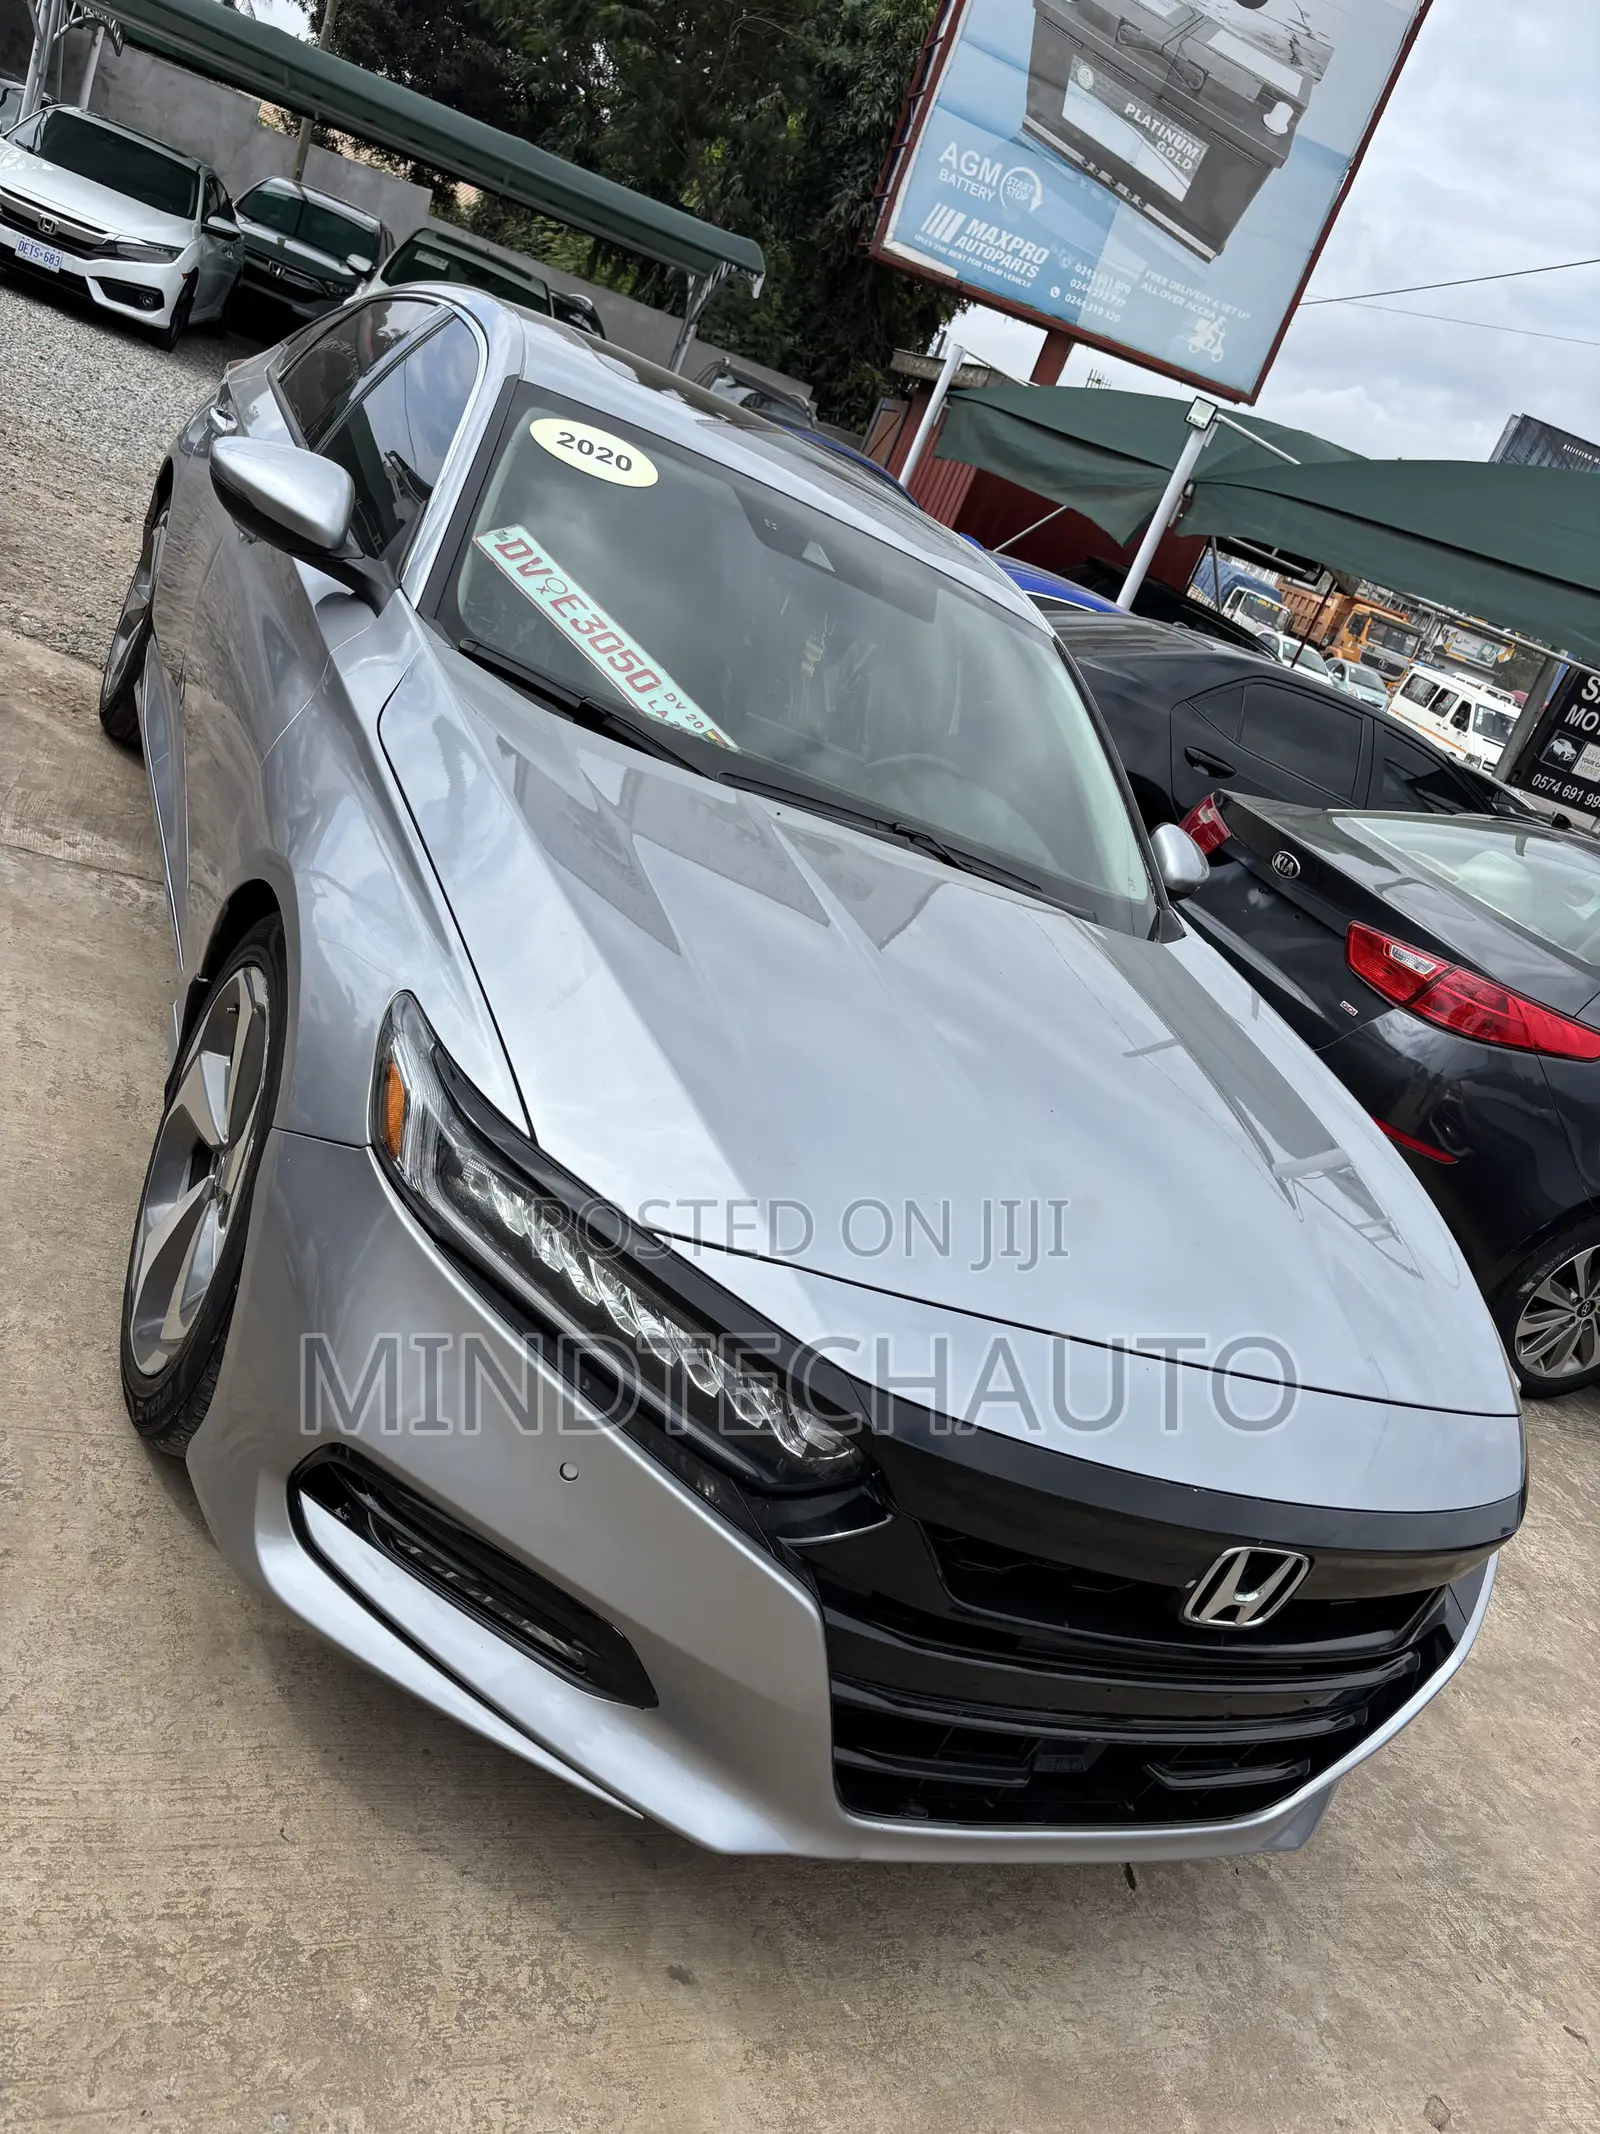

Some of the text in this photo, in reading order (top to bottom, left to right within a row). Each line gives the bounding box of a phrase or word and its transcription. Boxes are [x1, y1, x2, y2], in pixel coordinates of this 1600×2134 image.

[1124, 102, 1200, 159] PLATINUM
[938, 141, 1003, 187] AGM
[1157, 141, 1193, 170] GOLD
[938, 168, 995, 202] BATTERY
[1005, 186, 1029, 202] STOP
[1006, 176, 1034, 194] START
[954, 236, 1040, 278] AUTOPARTS
[965, 218, 1049, 265] MAXPRO
[43, 251, 61, 267] 683
[914, 234, 1033, 288] ONLY THE BEST FOR YOUR VEHICLE
[1140, 282, 1216, 321] ALL OVER ACCRA
[1144, 270, 1169, 287] FREE
[1168, 281, 1214, 304] DELIVERY
[555, 431, 633, 473] 2020
[1581, 675, 1600, 704] S
[647, 699, 669, 719] LA
[663, 692, 705, 729] DV 20
[1564, 703, 1600, 735] MO
[1581, 757, 1595, 767] YOUR
[1532, 773, 1600, 808] 0574 691 99
[1273, 853, 1295, 877] KIA
[1341, 1002, 1357, 1016] GDI
